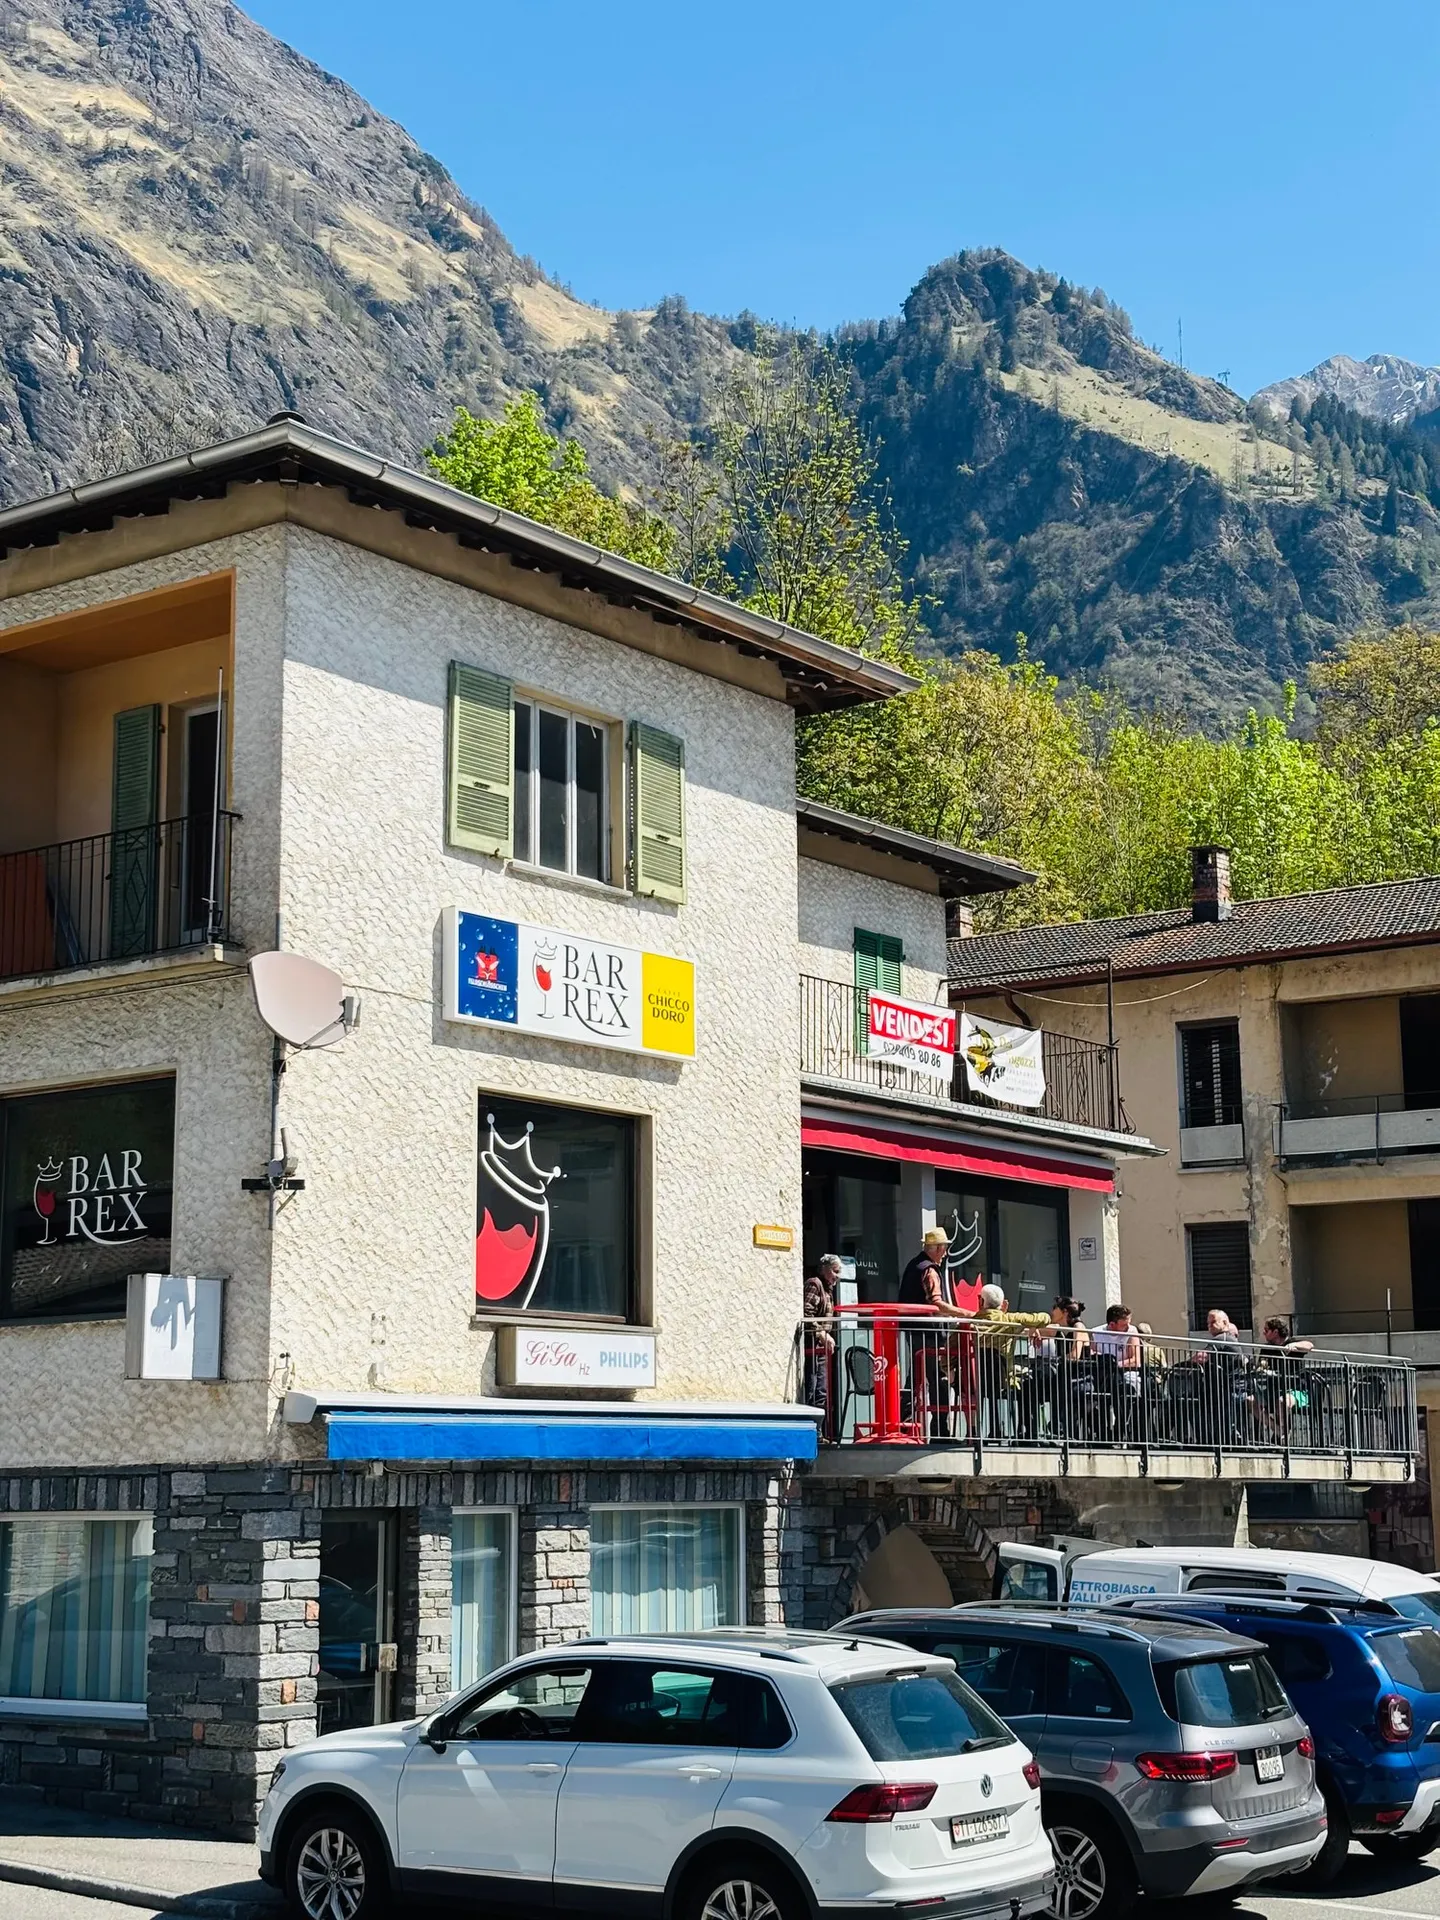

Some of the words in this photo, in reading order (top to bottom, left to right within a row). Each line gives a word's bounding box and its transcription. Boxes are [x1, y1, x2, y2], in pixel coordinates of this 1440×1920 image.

[562, 944, 628, 992] BAR
[562, 983, 632, 1038] REX
[648, 993, 690, 1012] CHICCO
[872, 1003, 949, 1048] VENDESI
[918, 1049, 930, 1065] 80
[931, 1053, 942, 1068] 86
[67, 1149, 148, 1195] BAR
[65, 1190, 149, 1245] REX
[578, 1363, 591, 1376] Hz
[599, 1351, 649, 1370] PHILIPS
